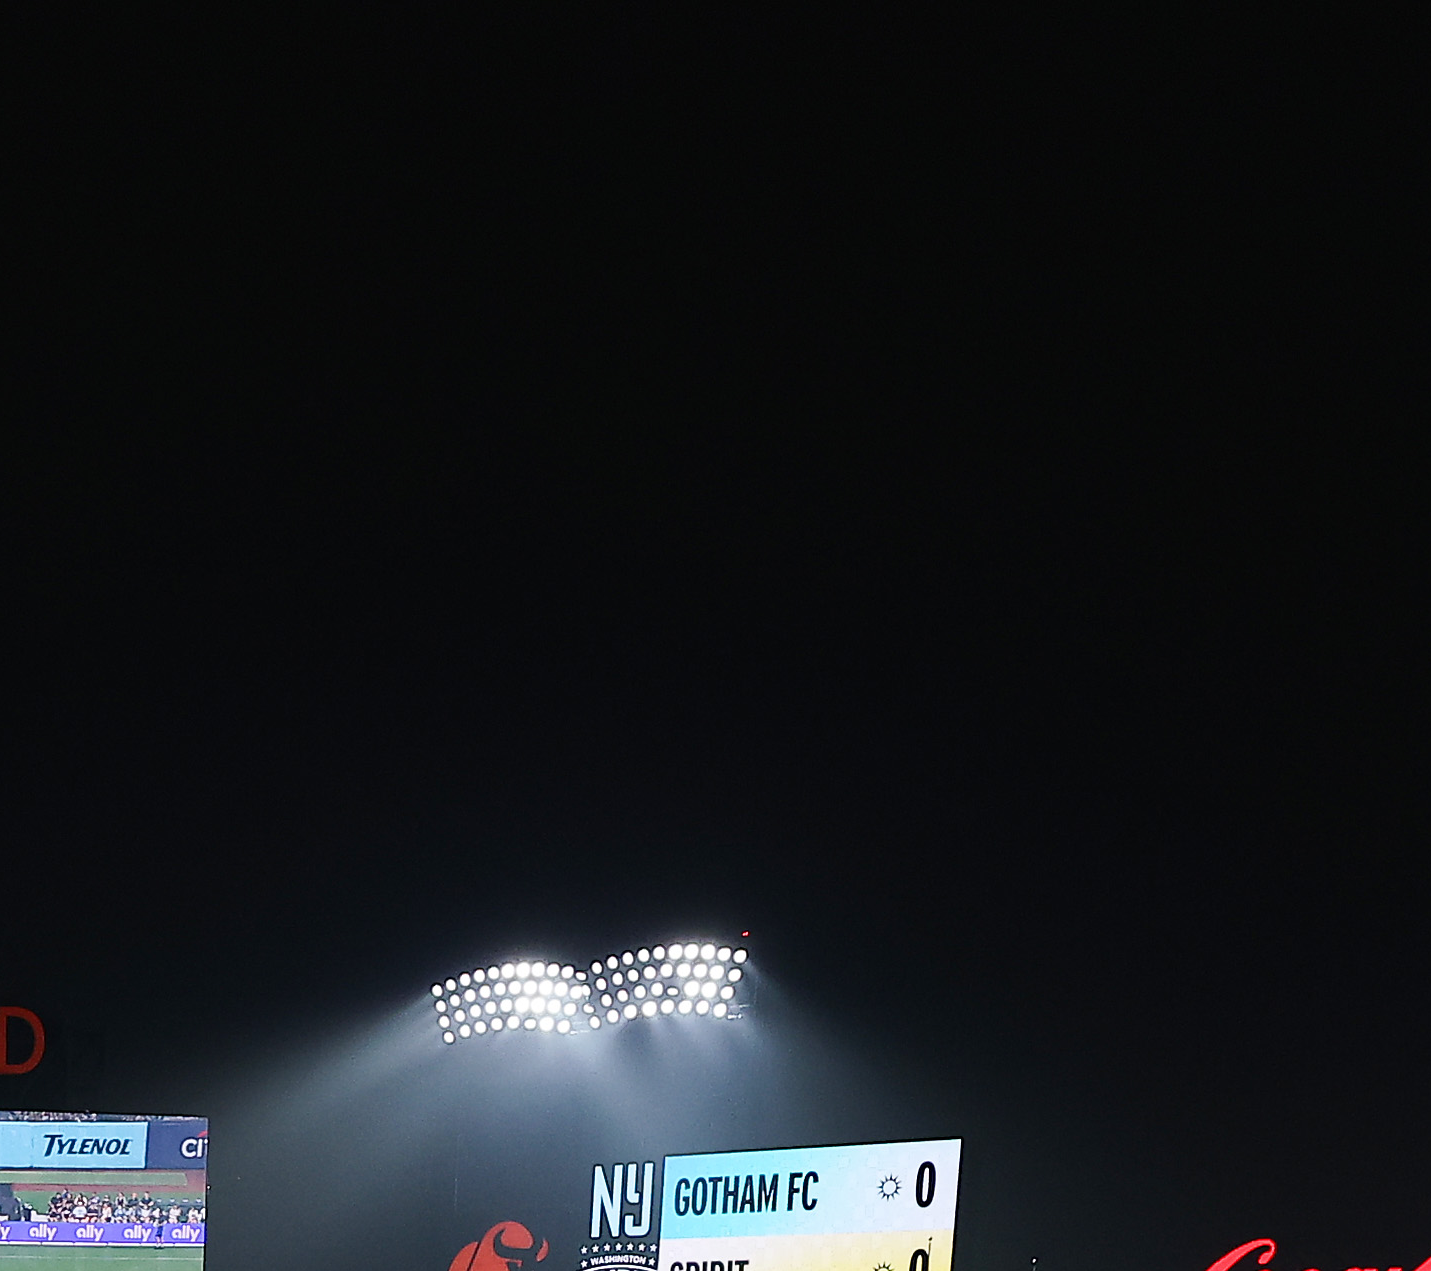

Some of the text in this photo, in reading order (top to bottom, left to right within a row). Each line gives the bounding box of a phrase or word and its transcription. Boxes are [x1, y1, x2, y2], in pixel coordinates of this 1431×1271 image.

[43, 1134, 133, 1157] TYLENOL
[589, 1163, 655, 1240] NY
[673, 1161, 938, 1217] GOTHAM FC 0
[589, 1253, 648, 1267] WASHINGTON
